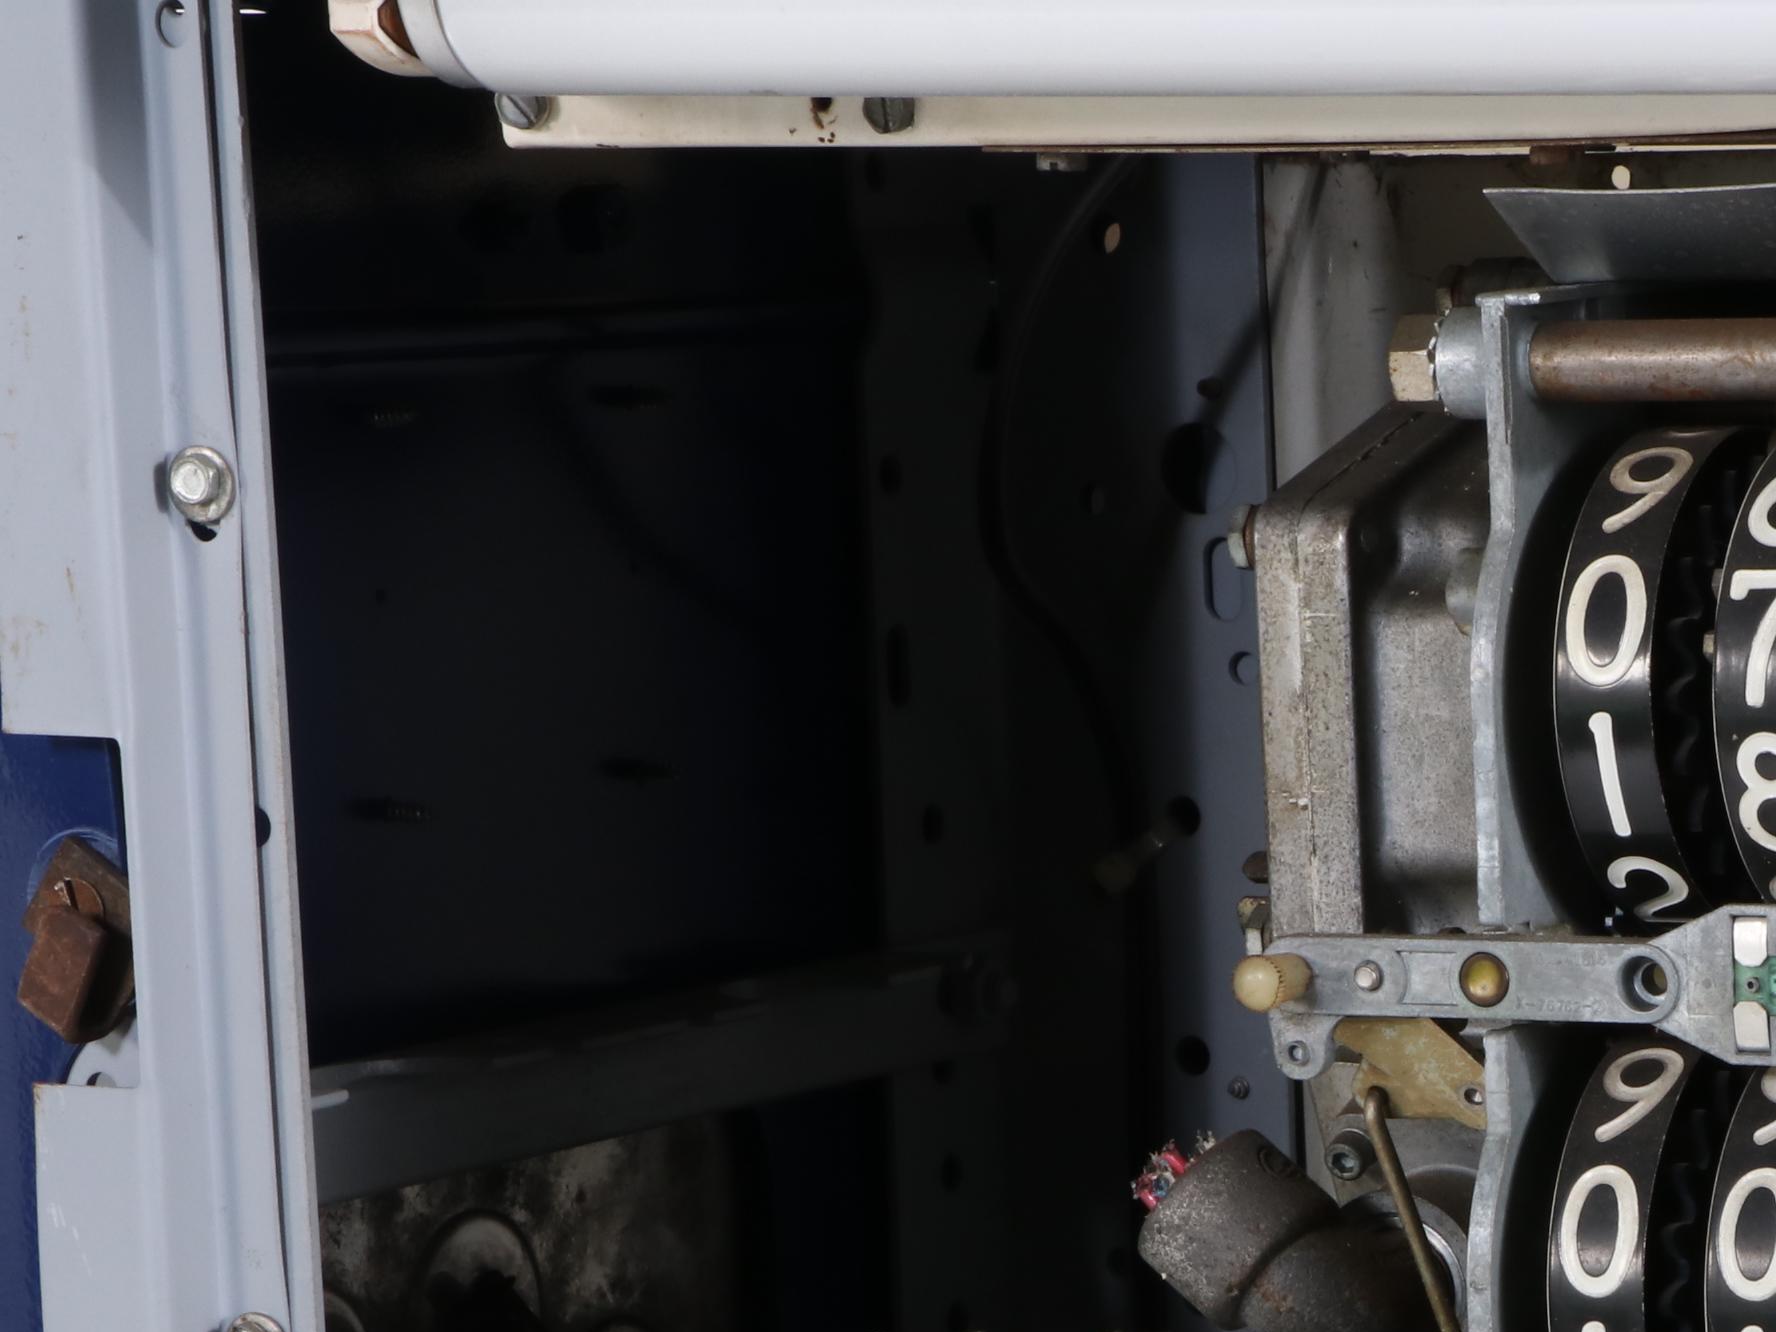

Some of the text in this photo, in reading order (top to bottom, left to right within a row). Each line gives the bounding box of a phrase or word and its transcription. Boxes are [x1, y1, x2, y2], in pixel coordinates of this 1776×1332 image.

[1603, 445, 1694, 533] 9
[1565, 554, 1647, 687] 0
[1589, 712, 1631, 838] 1
[1594, 1047, 1685, 1143] 9
[1561, 1164, 1640, 1299] 0
